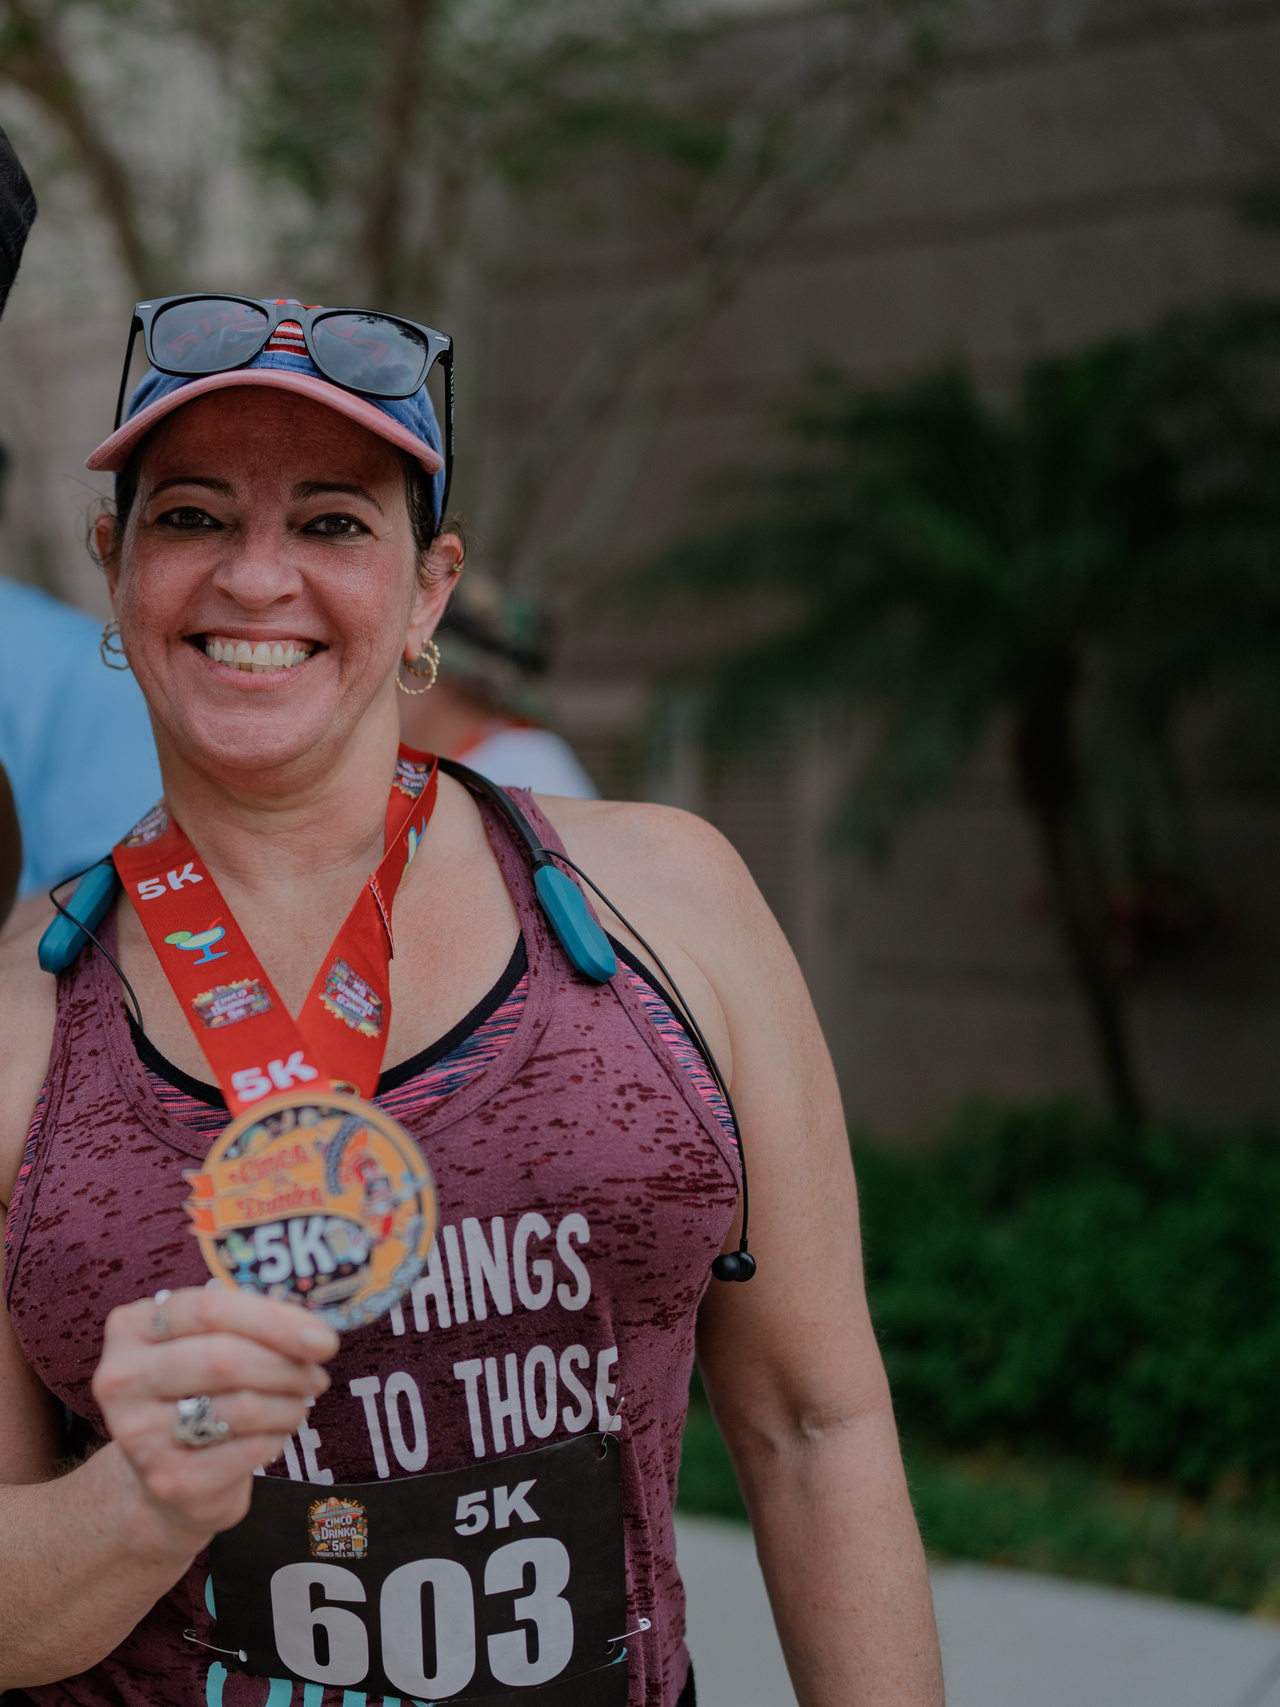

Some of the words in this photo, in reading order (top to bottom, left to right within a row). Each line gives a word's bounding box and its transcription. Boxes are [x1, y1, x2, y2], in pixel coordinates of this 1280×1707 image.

[137, 862, 204, 900] 5K
[230, 1051, 318, 1102] 5K
[253, 1214, 338, 1284] 5K
[349, 1371, 429, 1479] TO
[453, 1344, 622, 1458] THOSE
[325, 1515, 352, 1528] CINCO
[453, 1478, 540, 1536] 5K
[321, 1526, 357, 1540] DRINKO
[331, 1540, 346, 1551] 5K
[270, 1537, 574, 1700] 603
